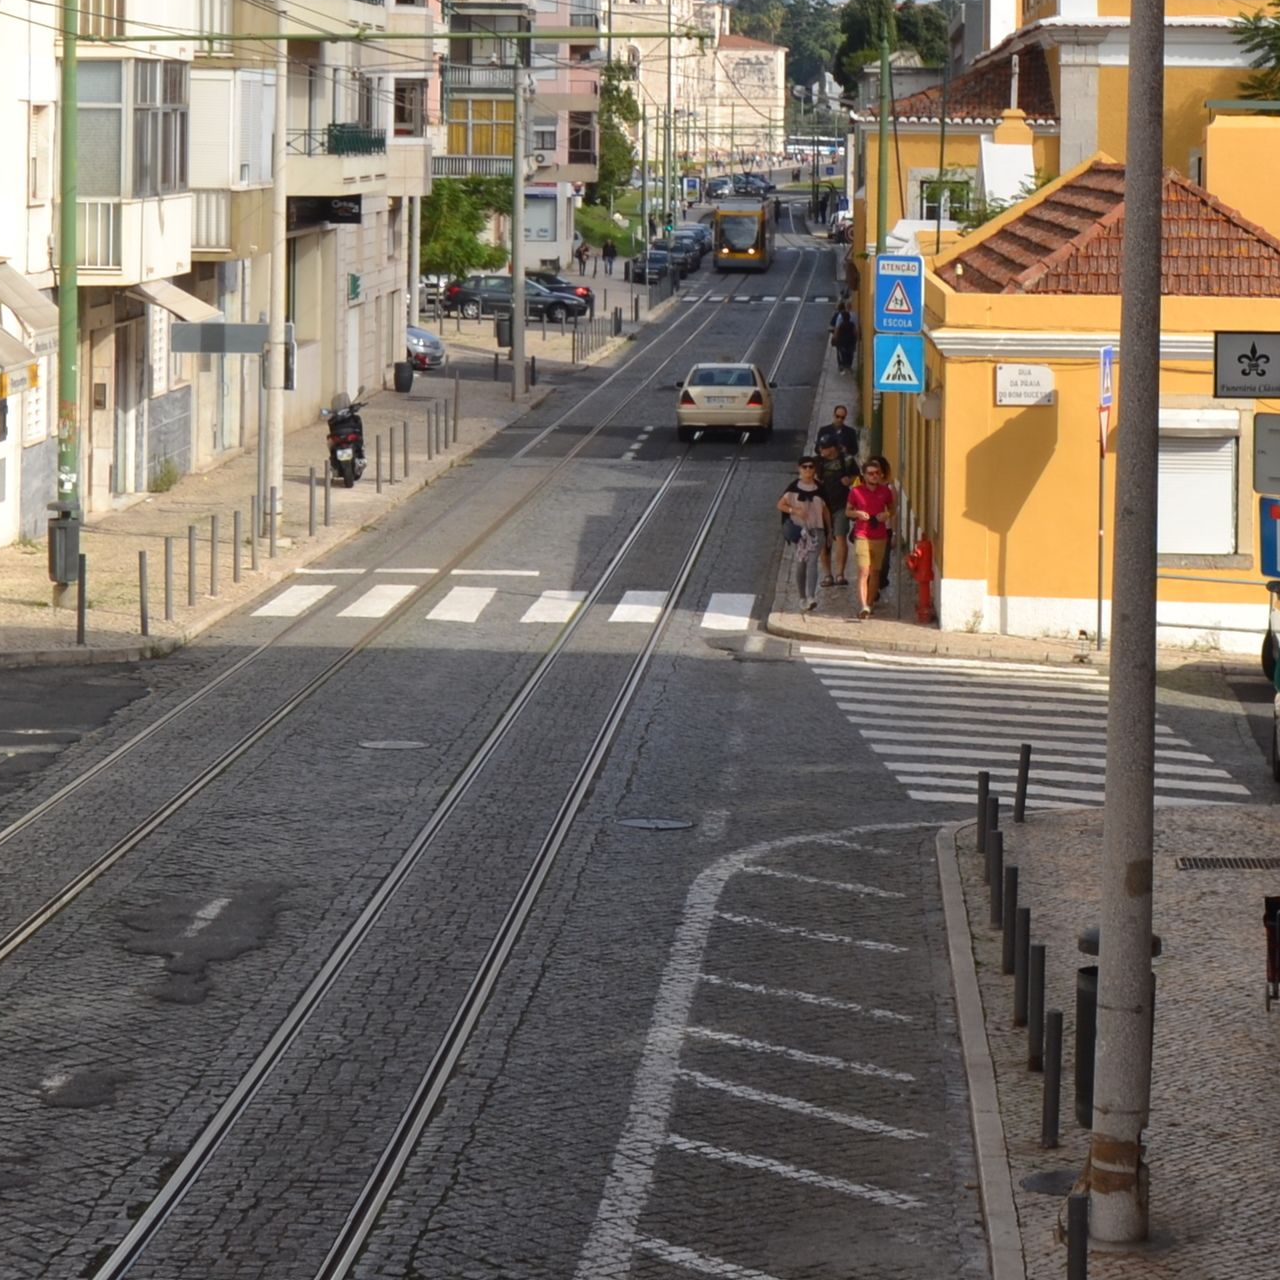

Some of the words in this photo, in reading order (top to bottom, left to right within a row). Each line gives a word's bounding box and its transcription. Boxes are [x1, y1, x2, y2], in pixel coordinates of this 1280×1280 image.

[881, 261, 917, 274] ATENÇÃO
[883, 318, 913, 328] ESCOLA
[1017, 368, 1032, 376] RUA
[1009, 379, 1019, 387] DA
[1020, 379, 1041, 387] PRAIA
